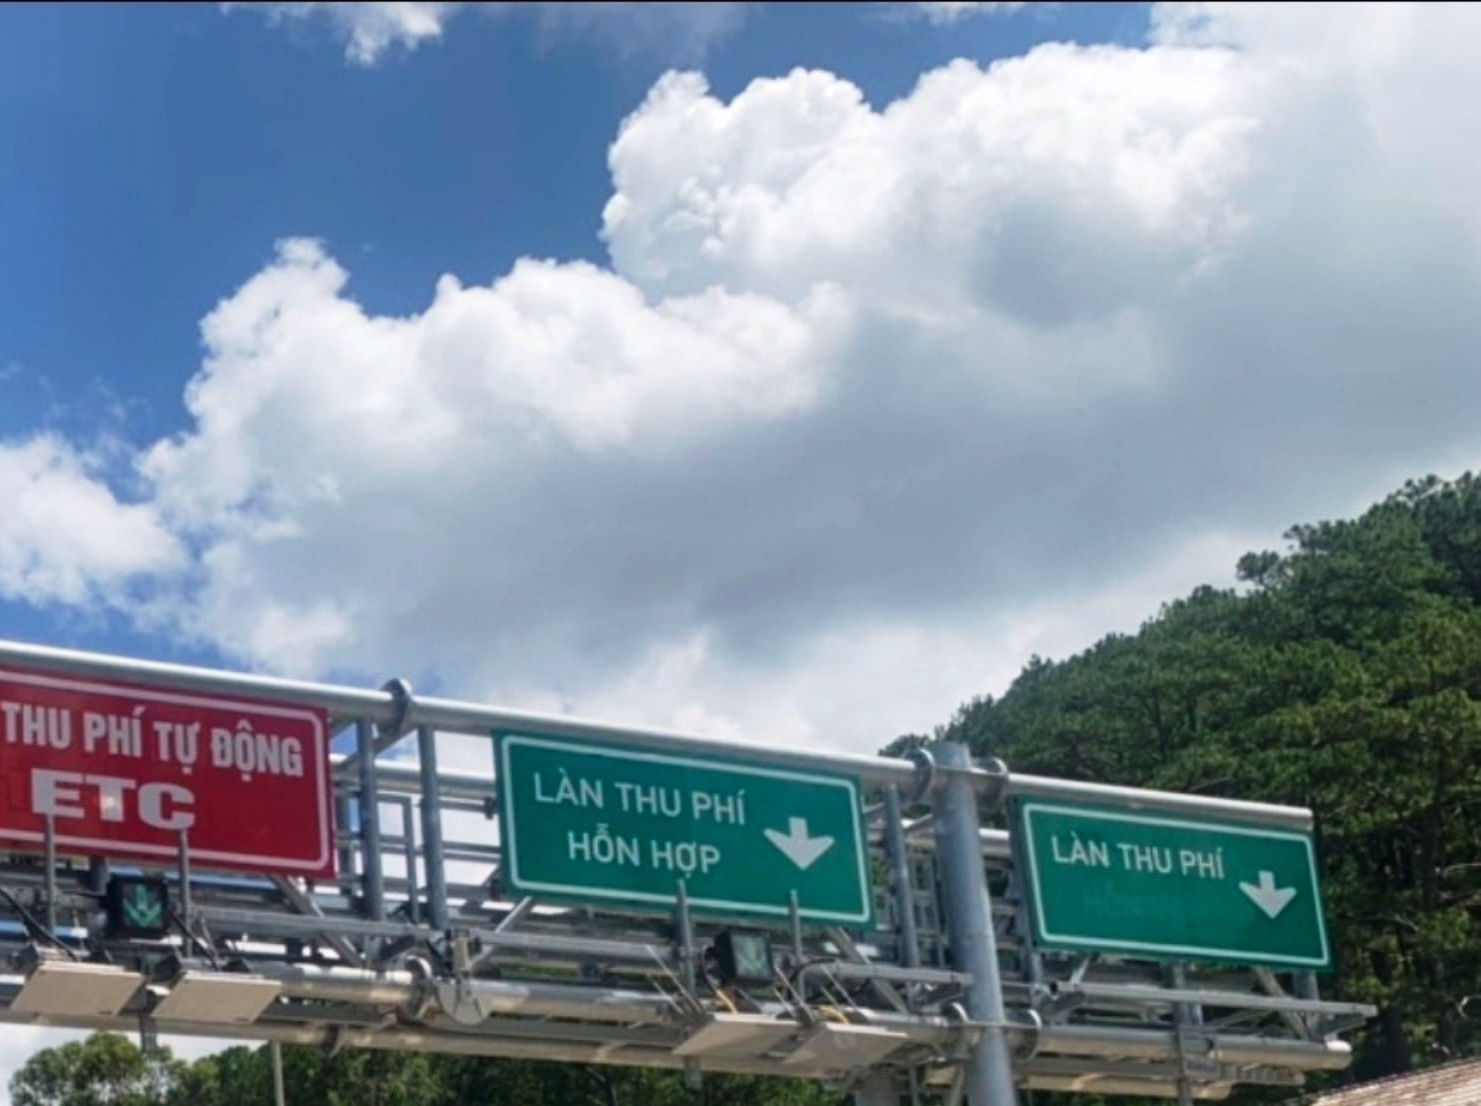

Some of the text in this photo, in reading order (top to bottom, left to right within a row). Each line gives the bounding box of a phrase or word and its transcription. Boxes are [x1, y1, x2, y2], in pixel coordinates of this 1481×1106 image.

[0, 700, 72, 750] THU
[83, 705, 146, 758] PHÍ
[152, 720, 201, 775] TỰ
[210, 719, 305, 782] ĐỘNG
[30, 768, 196, 831] ETC
[533, 767, 748, 825] LÀN THU PHÍ
[567, 822, 721, 880] HỖN HỢP
[1050, 830, 1225, 879] LÀN THU PHÍ
